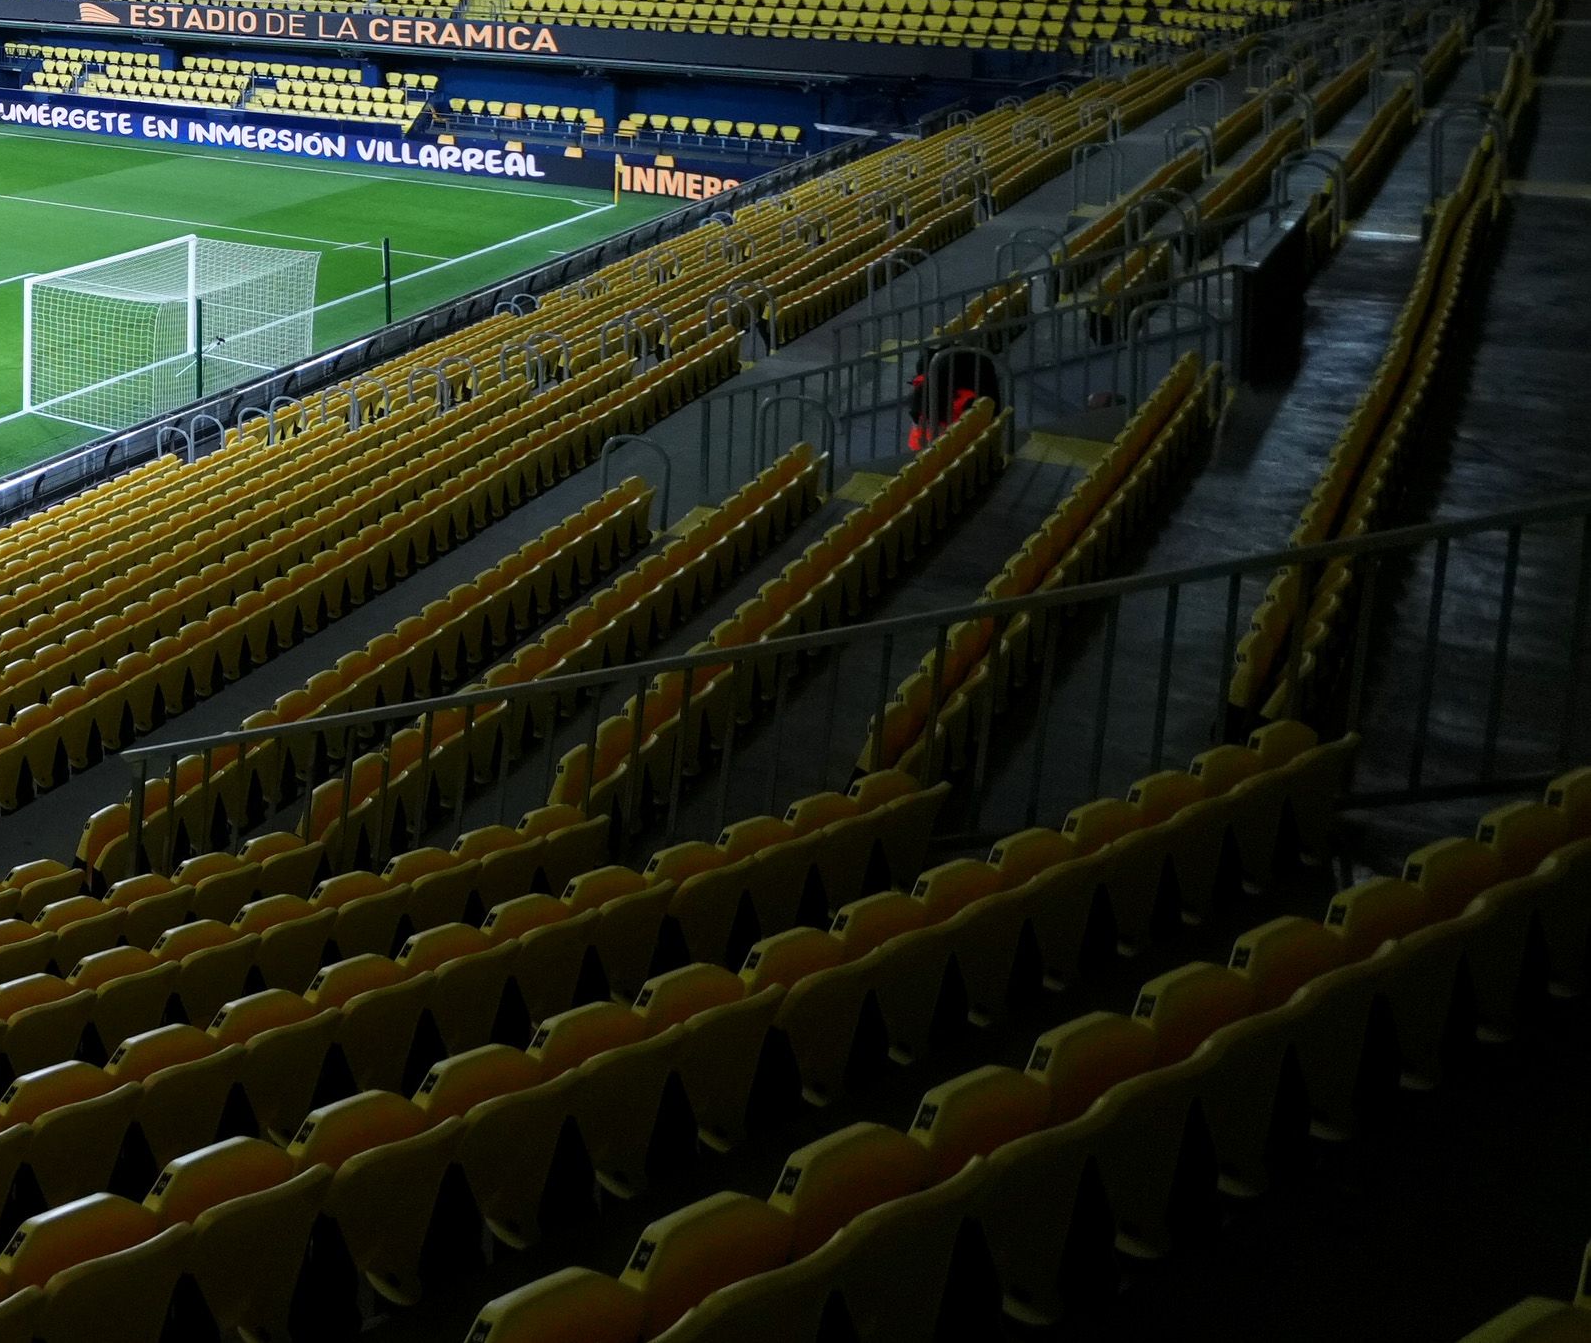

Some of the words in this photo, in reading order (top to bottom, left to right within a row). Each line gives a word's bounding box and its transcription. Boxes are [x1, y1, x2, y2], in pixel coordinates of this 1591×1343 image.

[129, 4, 257, 34] ESTADIO
[265, 13, 306, 36] DE
[318, 15, 357, 40] LA
[368, 18, 558, 53] CERAMICA
[142, 116, 178, 139] EN
[188, 121, 346, 158] INMERSIÓN
[356, 139, 545, 178] VILLARREAL
